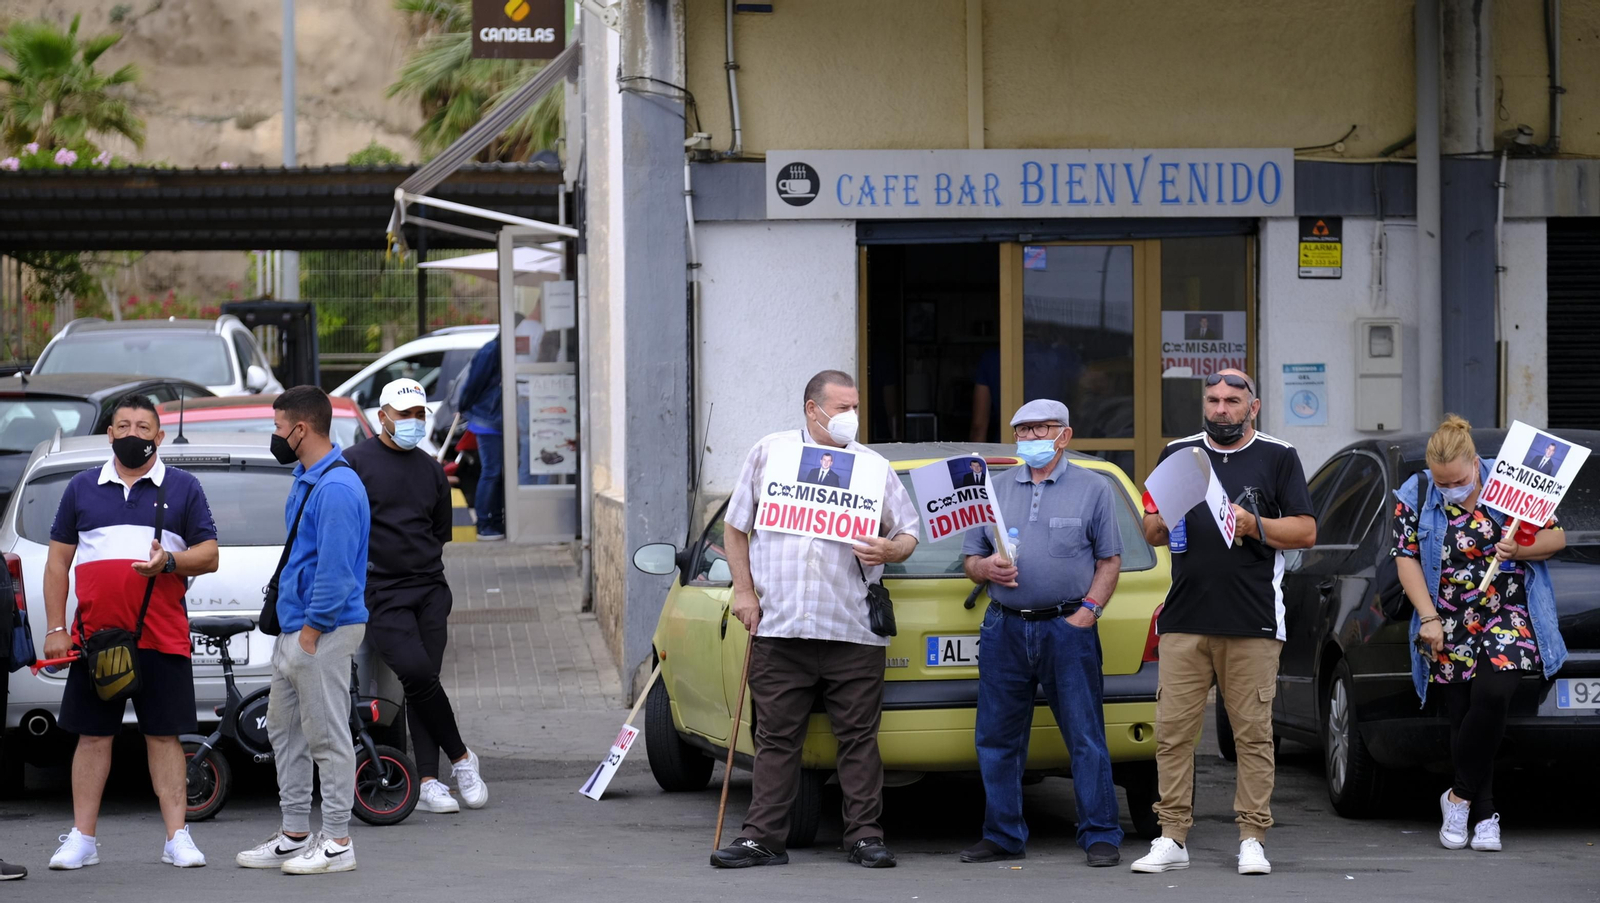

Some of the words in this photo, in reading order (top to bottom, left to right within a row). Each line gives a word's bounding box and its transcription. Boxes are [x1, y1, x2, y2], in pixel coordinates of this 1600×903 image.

[480, 27, 556, 42] CANDELAS
[836, 173, 919, 206] CAFE
[934, 173, 1001, 207] BAR
[1019, 154, 1283, 207] BIENVENIDO
[1481, 478, 1556, 523] ¡DIMISIÓN!
[759, 502, 876, 540] ¡DIMISIÓN!
[943, 640, 970, 662] AL
[1574, 682, 1600, 704] 92
